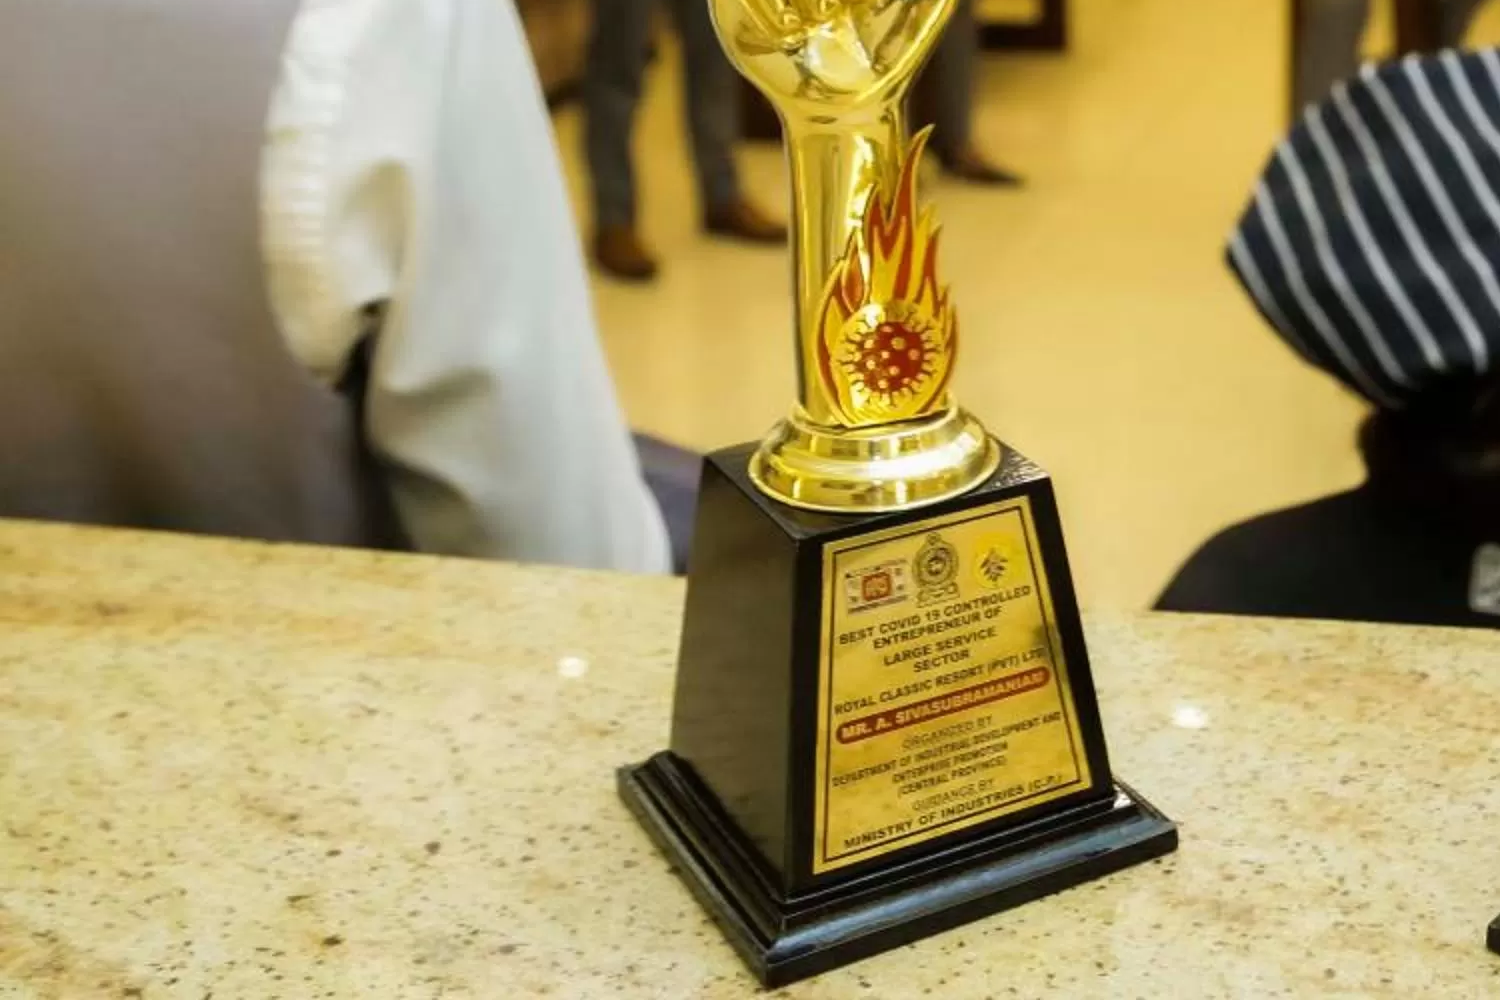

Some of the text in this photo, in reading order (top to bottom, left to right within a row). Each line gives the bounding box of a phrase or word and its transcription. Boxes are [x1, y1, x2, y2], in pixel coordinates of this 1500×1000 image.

[839, 585, 1031, 645] BEST COVID 19 CONTROLLED
[873, 606, 1002, 649] ENTREPRENEUR OF
[884, 627, 998, 666] LARGE SERVICE
[914, 650, 970, 673] SECTOR
[834, 695, 876, 715] ROYAL
[880, 679, 932, 703] CLASSIC
[936, 665, 984, 687] RESORT
[842, 722, 872, 738] MR.
[876, 717, 892, 731] A.
[902, 716, 993, 749] ORGANIZED BY
[832, 760, 896, 787] DEPARTMENT
[900, 756, 912, 766] OF
[973, 718, 1039, 745] DEVELOPMENT
[1042, 712, 1061, 723] AND
[892, 759, 950, 784] ENTERPRISE
[912, 778, 994, 811] GUIDANCE BY
[844, 821, 913, 848] MINISTRY
[918, 811, 937, 825] OF
[941, 784, 1024, 818] INDUSTRIES
